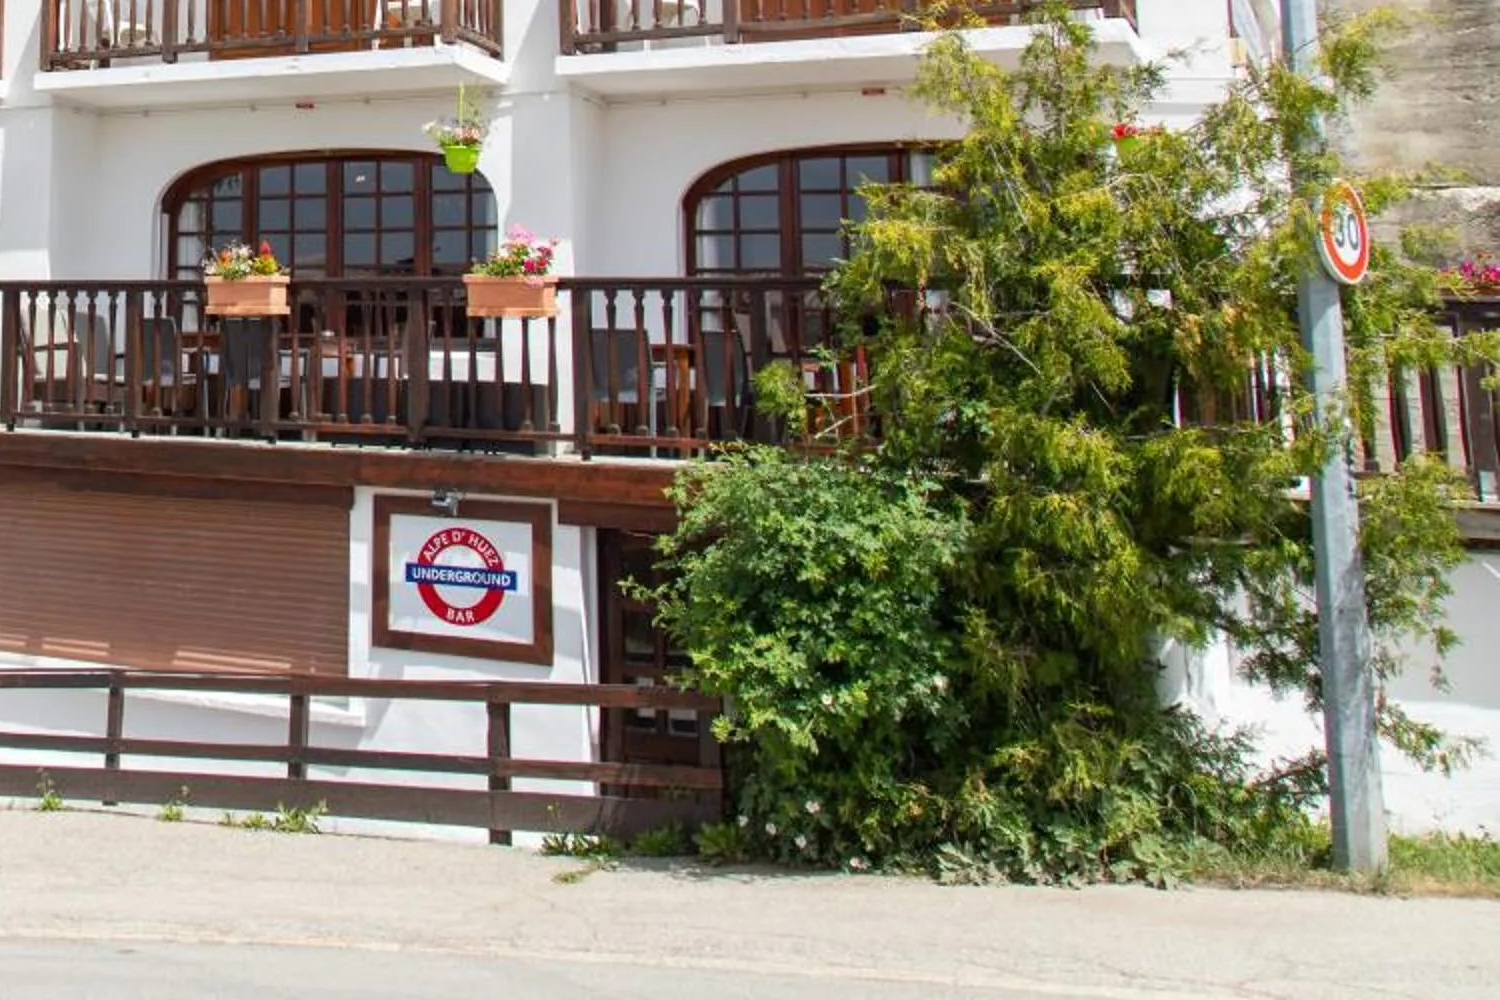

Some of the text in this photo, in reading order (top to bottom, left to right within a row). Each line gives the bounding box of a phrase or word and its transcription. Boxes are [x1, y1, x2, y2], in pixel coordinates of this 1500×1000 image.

[1334, 205, 1359, 250] 30
[423, 534, 450, 561] ALPE
[468, 533, 500, 566] HUEZ
[412, 567, 511, 587] UNDERGROUND
[447, 608, 475, 622] BAR
